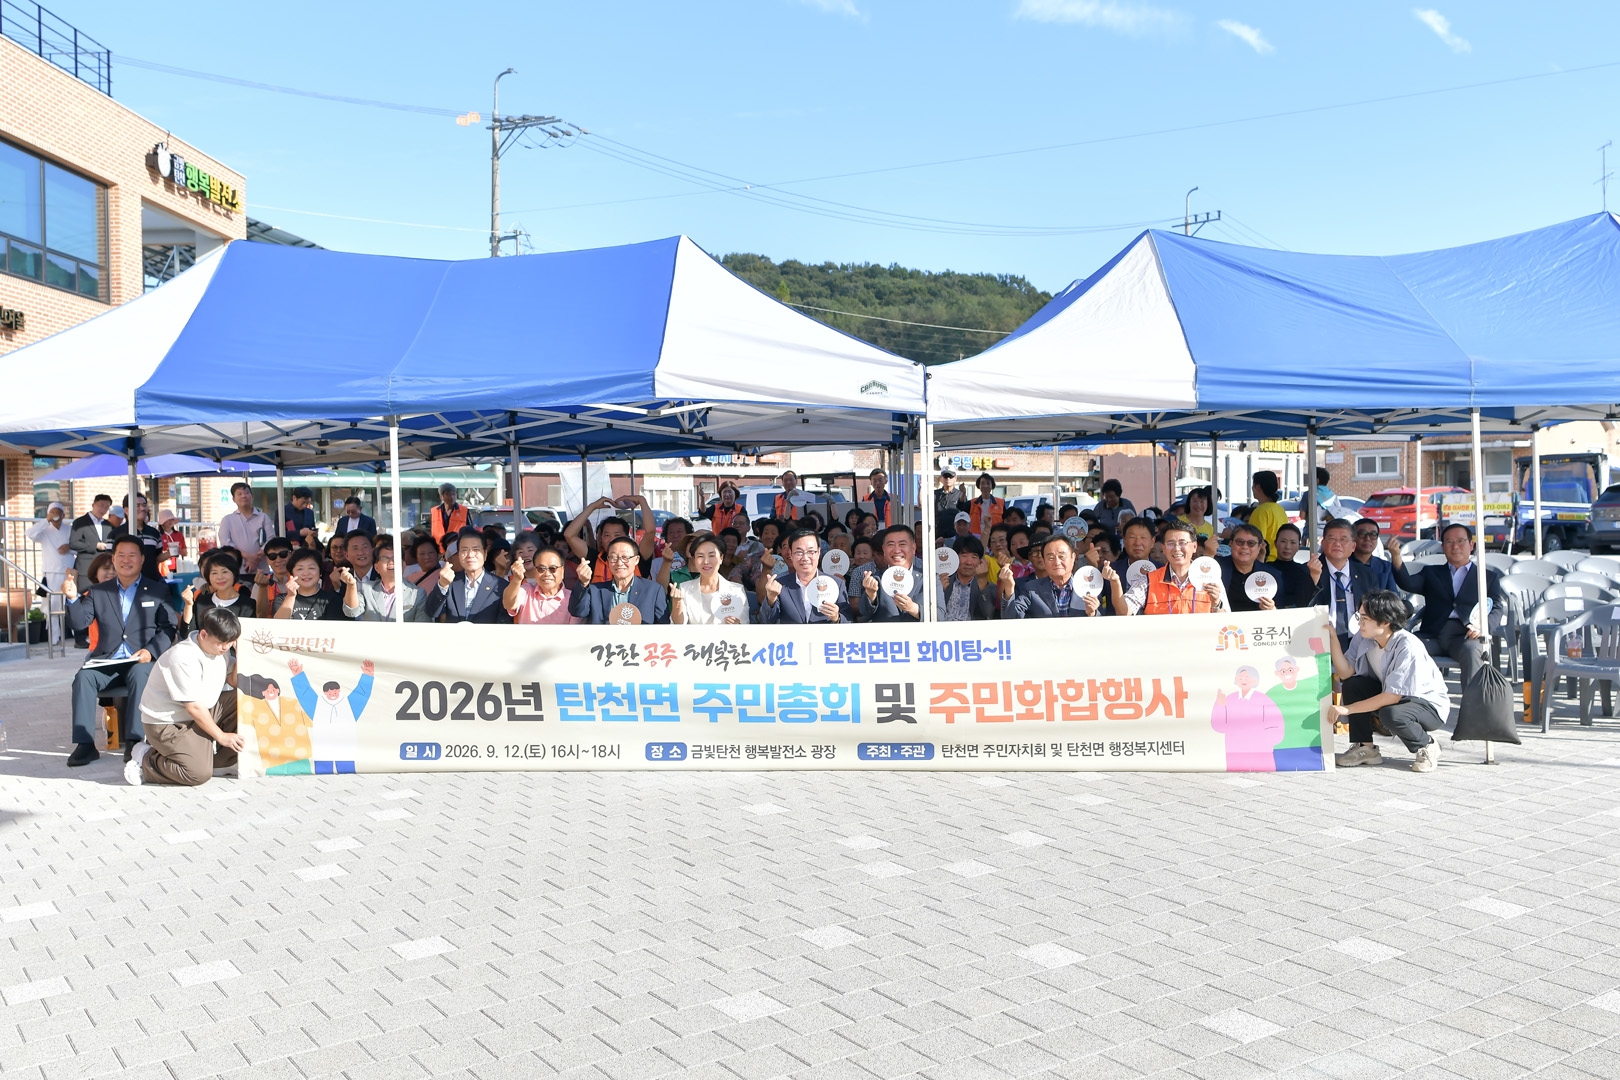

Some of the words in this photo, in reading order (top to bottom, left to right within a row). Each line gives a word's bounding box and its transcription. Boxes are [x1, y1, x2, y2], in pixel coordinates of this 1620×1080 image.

[185, 162, 243, 214] 행복발전소
[952, 455, 993, 469] 우정식당
[1251, 626, 1292, 641] 공주시
[276, 636, 335, 654] 금빛탄천
[824, 641, 910, 664] 탄천면민
[917, 640, 1011, 662] 화이팅~!!
[590, 643, 639, 667] 강한
[644, 643, 677, 667] 공주
[683, 640, 751, 671] 행복한
[752, 642, 798, 666] 시민
[395, 680, 544, 721] 2026년
[555, 682, 680, 722] 탄천면
[692, 683, 861, 723] 주민총회
[875, 683, 917, 724] 및
[930, 677, 1188, 724] 주민화합행사
[445, 745, 481, 758] 2026.
[487, 745, 498, 758] 9.
[504, 744, 546, 759] 12.(토)
[551, 744, 620, 759] 16시~18시
[691, 745, 740, 759] 금빛탄천
[745, 745, 806, 759] 행복발전소
[811, 745, 836, 759] 광장
[942, 744, 978, 758] 탄천면
[983, 743, 1045, 757] 주민자치회
[1051, 743, 1062, 757] 및
[1067, 742, 1104, 756] 탄천면
[1109, 741, 1184, 756] 행정복지센터
